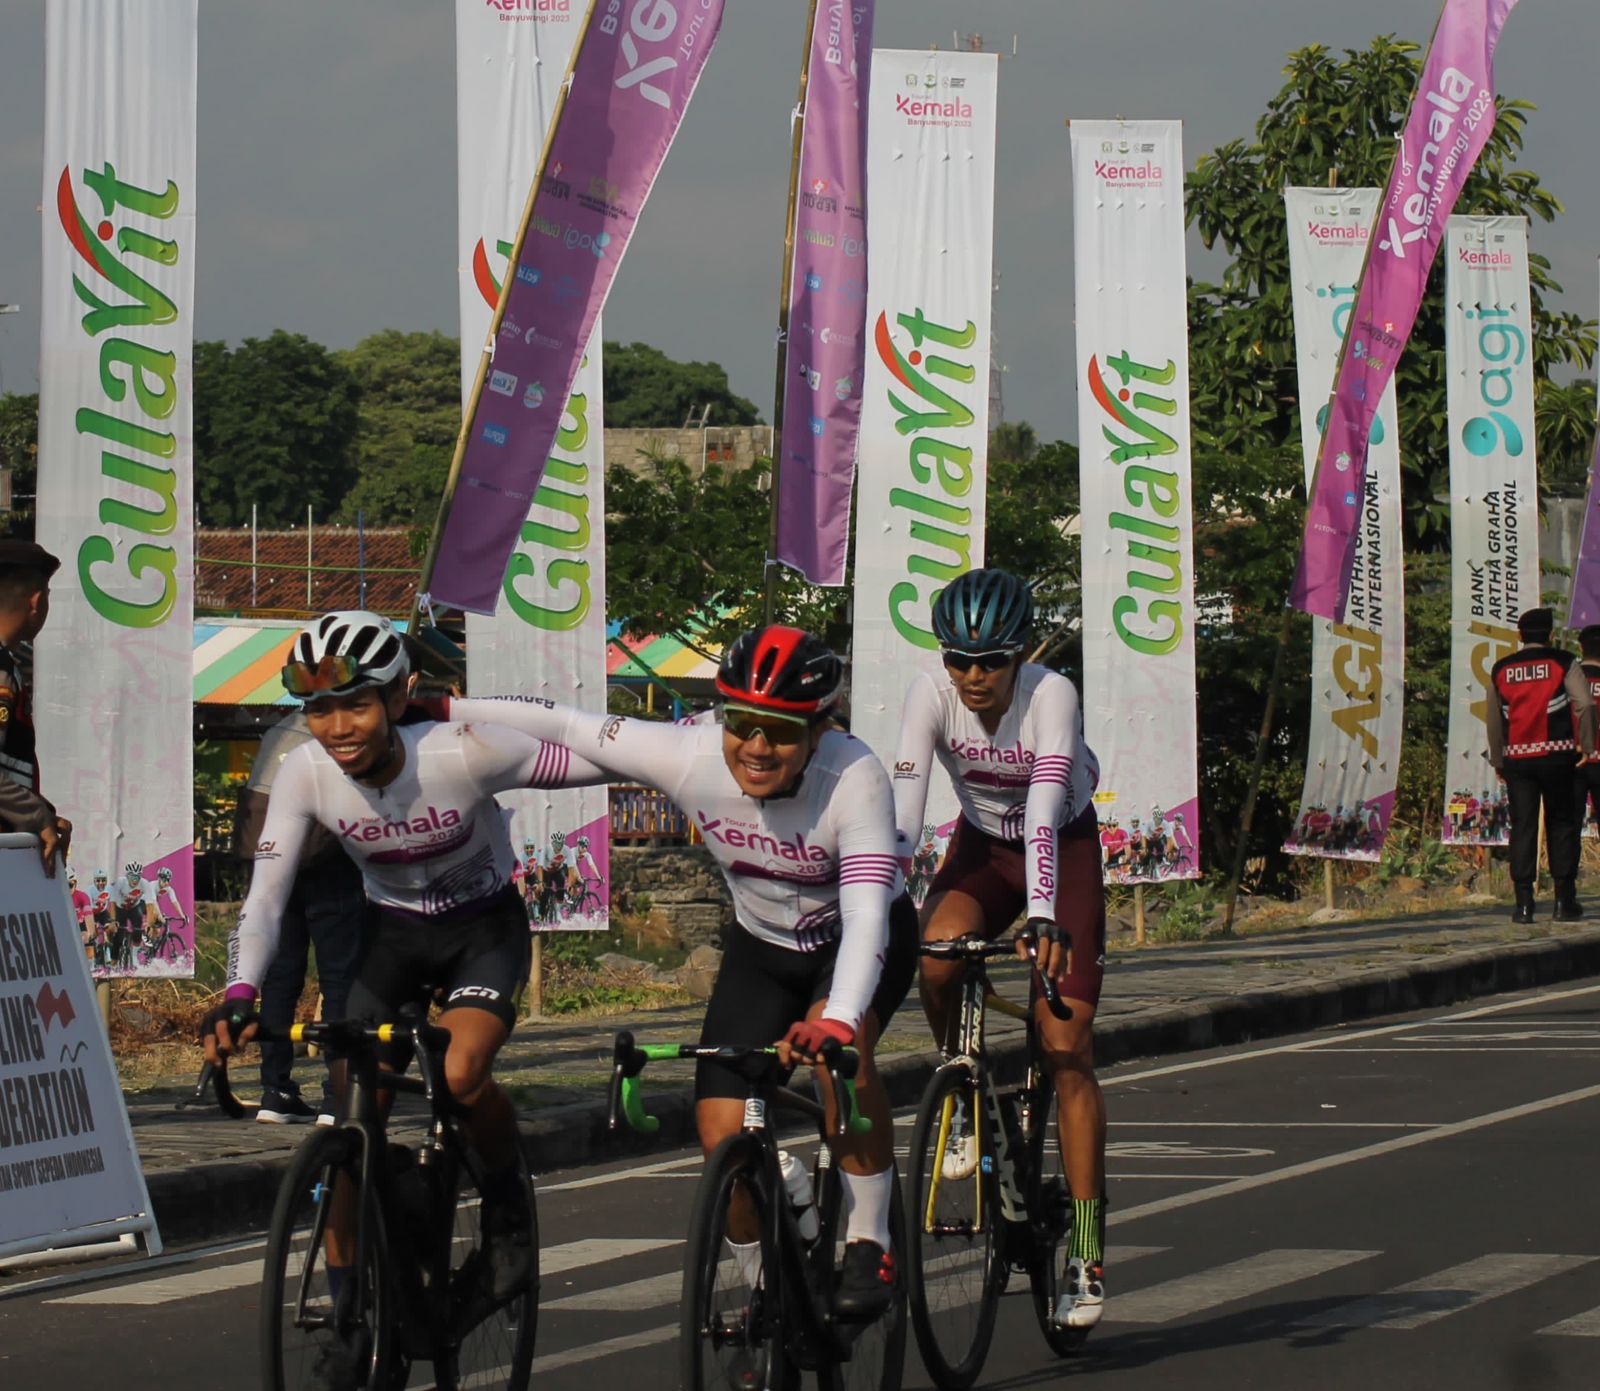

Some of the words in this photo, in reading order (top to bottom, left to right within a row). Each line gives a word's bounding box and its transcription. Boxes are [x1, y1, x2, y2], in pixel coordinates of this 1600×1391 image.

[499, 13, 549, 23] Banyuwangi
[896, 93, 972, 118] Kemala
[1463, 88, 1492, 132] 2023
[1095, 160, 1162, 179] Kemala
[1378, 67, 1475, 258] Kemala
[1308, 221, 1369, 238] Kemala
[1459, 247, 1511, 265] Kemala
[1488, 490, 1500, 554] GRAHA
[1366, 469, 1383, 627] INTERNASIONAL
[1506, 479, 1519, 625] INTERNASIONAL
[1351, 558, 1364, 621] ARTHA
[1471, 565, 1485, 617] BANK
[1488, 558, 1501, 620] ARTHA
[1332, 622, 1383, 760] AGI
[1506, 664, 1549, 682] POLISI
[951, 738, 1036, 765] Kemala
[338, 806, 461, 842] Kemala
[698, 810, 832, 862] Kemala
[724, 817, 747, 827] Tour
[1031, 824, 1054, 902] Kemala
[11, 1160, 38, 1190] SPORT
[35, 1155, 67, 1185] SEPEDA
[63, 1146, 105, 1179] INDONESIA
